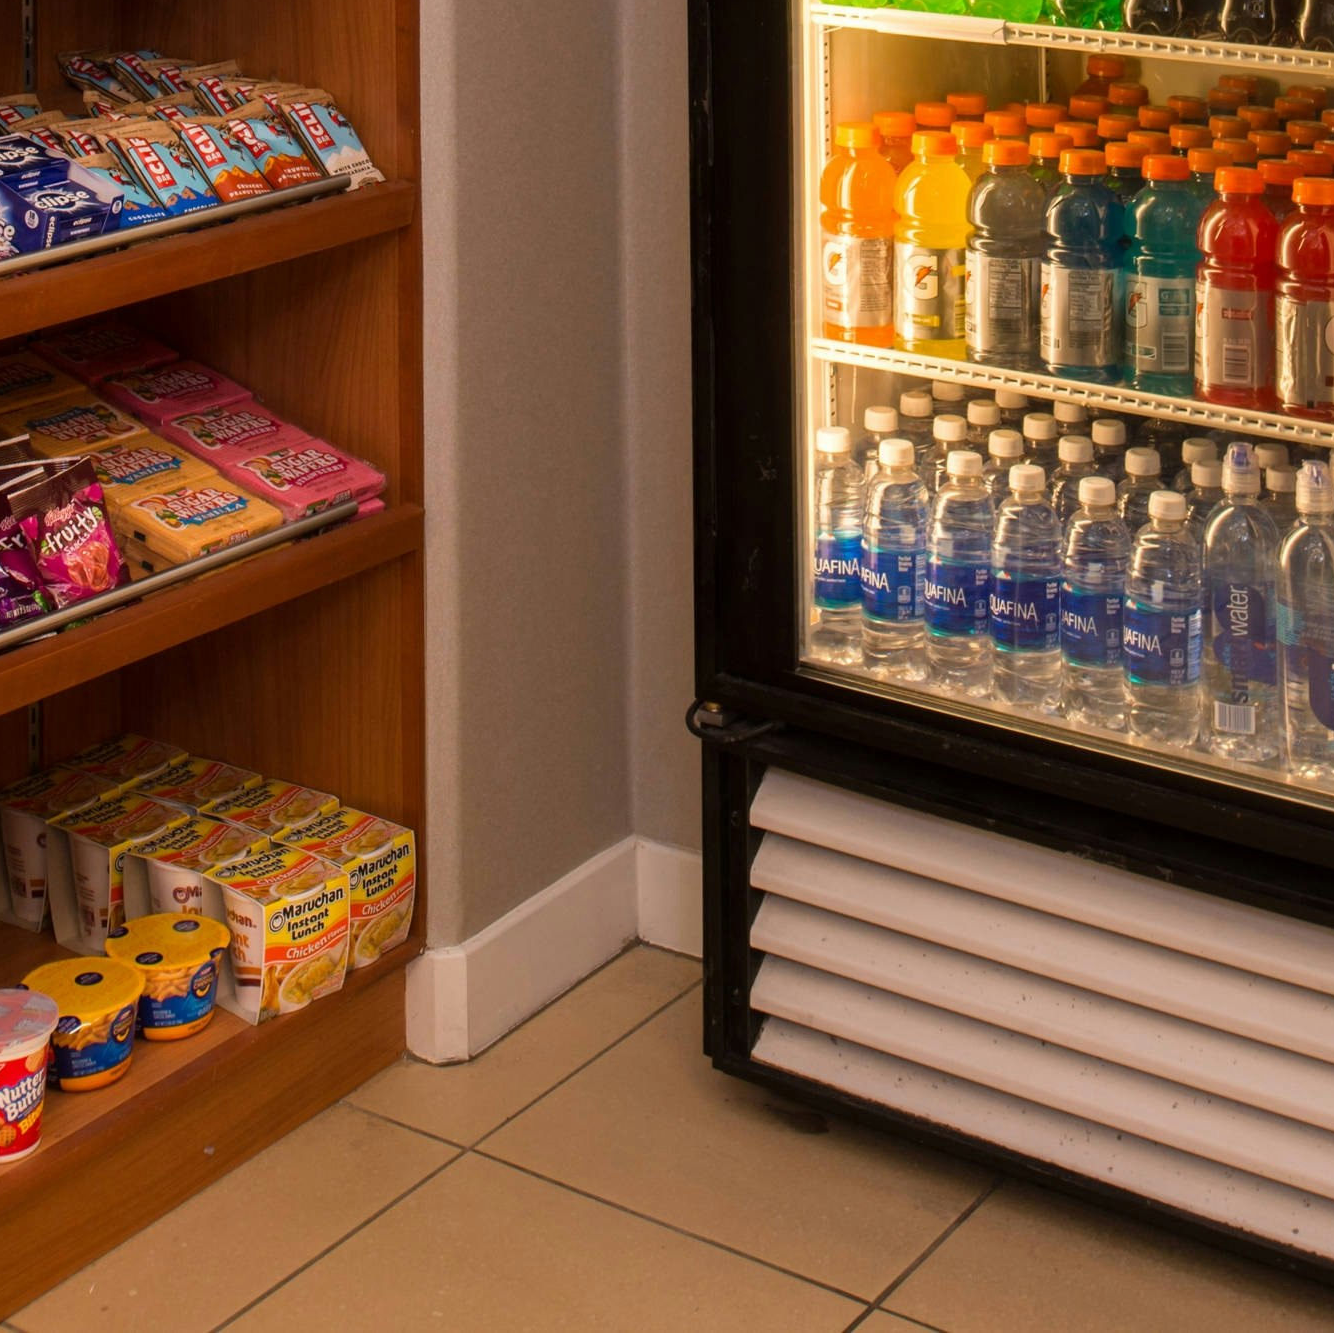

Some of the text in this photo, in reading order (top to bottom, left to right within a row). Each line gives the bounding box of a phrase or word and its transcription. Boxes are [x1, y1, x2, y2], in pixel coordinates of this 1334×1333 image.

[130, 137, 166, 177] CLIF
[206, 152, 222, 163] BAR
[157, 173, 171, 185] BAR
[36, 189, 91, 210] eclipse
[48, 216, 56, 250] eclipse
[101, 448, 154, 470] SUGAR
[110, 452, 174, 479] WAFERS
[275, 449, 324, 473] SUGAR
[280, 454, 339, 481] WAFERS
[295, 463, 346, 487] STRAWBERRY
[169, 488, 219, 511] SUGAR
[174, 492, 240, 519] WAFERS
[194, 502, 244, 523] VANILLA
[44, 509, 101, 554] fruity
[989, 594, 1038, 621] QUAFINA
[1227, 584, 1248, 636] water
[357, 844, 409, 877] Maruchan
[362, 865, 398, 889] Instant
[366, 878, 394, 898] Lunch
[283, 888, 344, 919] Maruchan
[362, 892, 397, 916] Chicken
[287, 909, 329, 932] Instant
[291, 922, 325, 941] Lunch
[286, 938, 327, 960] Chicken
